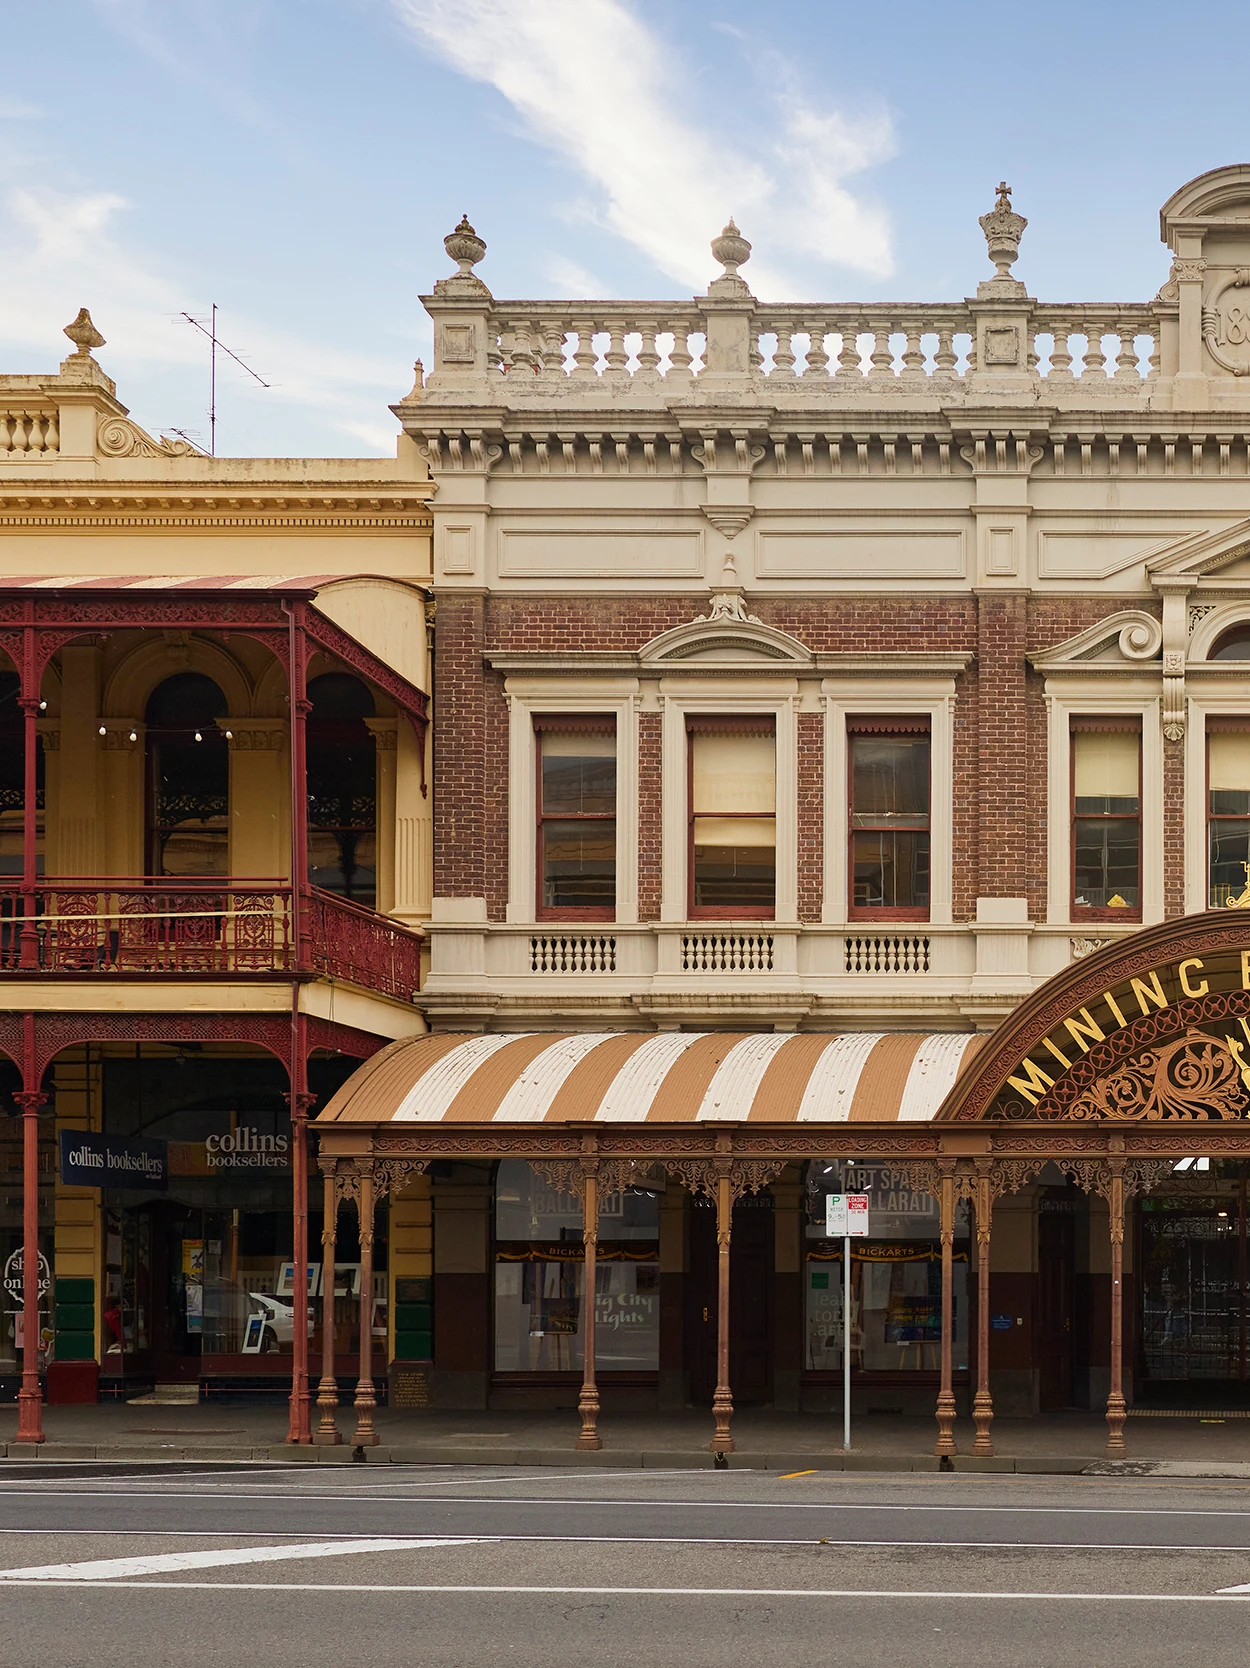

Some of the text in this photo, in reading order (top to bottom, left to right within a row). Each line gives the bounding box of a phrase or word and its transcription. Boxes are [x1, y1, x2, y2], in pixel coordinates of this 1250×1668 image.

[1006, 956, 1210, 1108] MINING
[206, 1127, 288, 1153] collins
[68, 1146, 163, 1173] collins booksellers
[206, 1153, 288, 1168] booksellers
[846, 1169, 877, 1189] ART
[535, 1192, 617, 1213] BALLAAT
[832, 1196, 841, 1206] P
[859, 1247, 915, 1257] BICKARTS
[11, 1256, 44, 1274] shp
[617, 1293, 653, 1313] City
[595, 1310, 645, 1332] Lights
